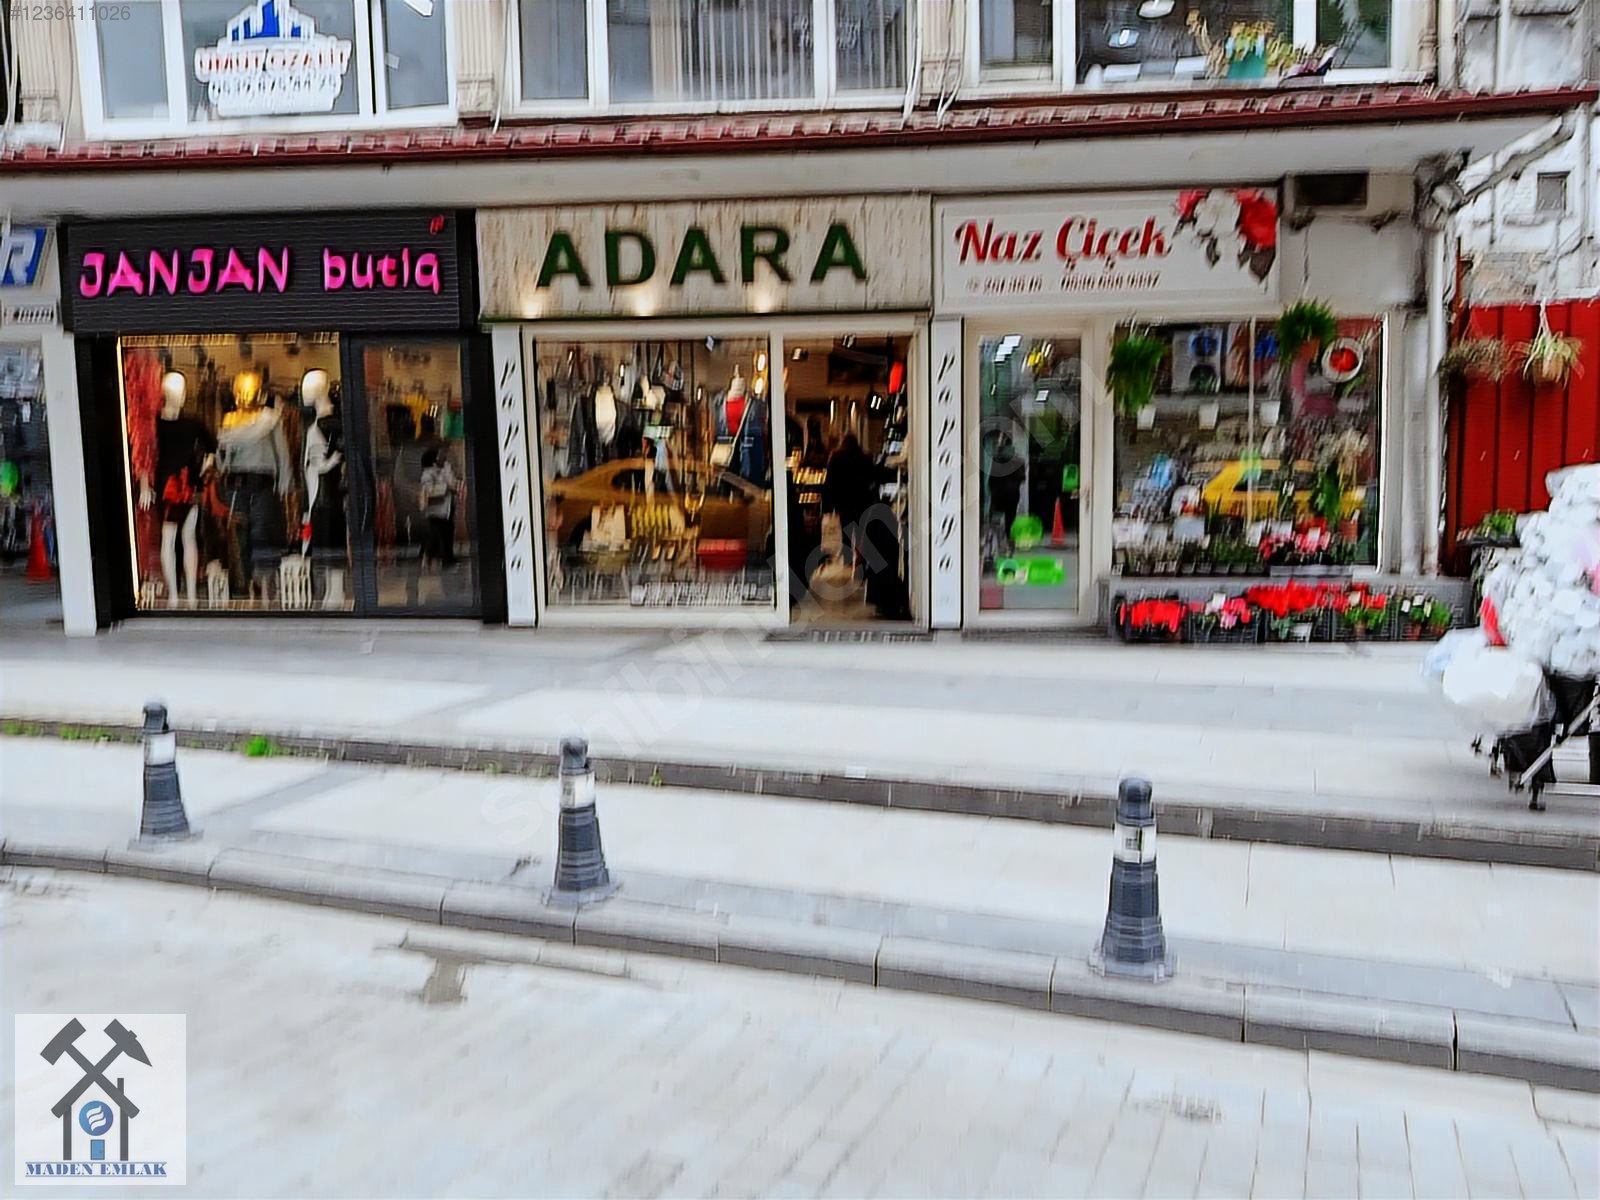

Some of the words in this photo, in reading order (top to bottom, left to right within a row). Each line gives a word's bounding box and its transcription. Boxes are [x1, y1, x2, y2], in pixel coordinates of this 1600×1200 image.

[536, 223, 868, 288] ADARA
[954, 218, 1042, 265] Naz
[1055, 214, 1172, 272] Çiçek
[79, 246, 290, 299] JANJAN
